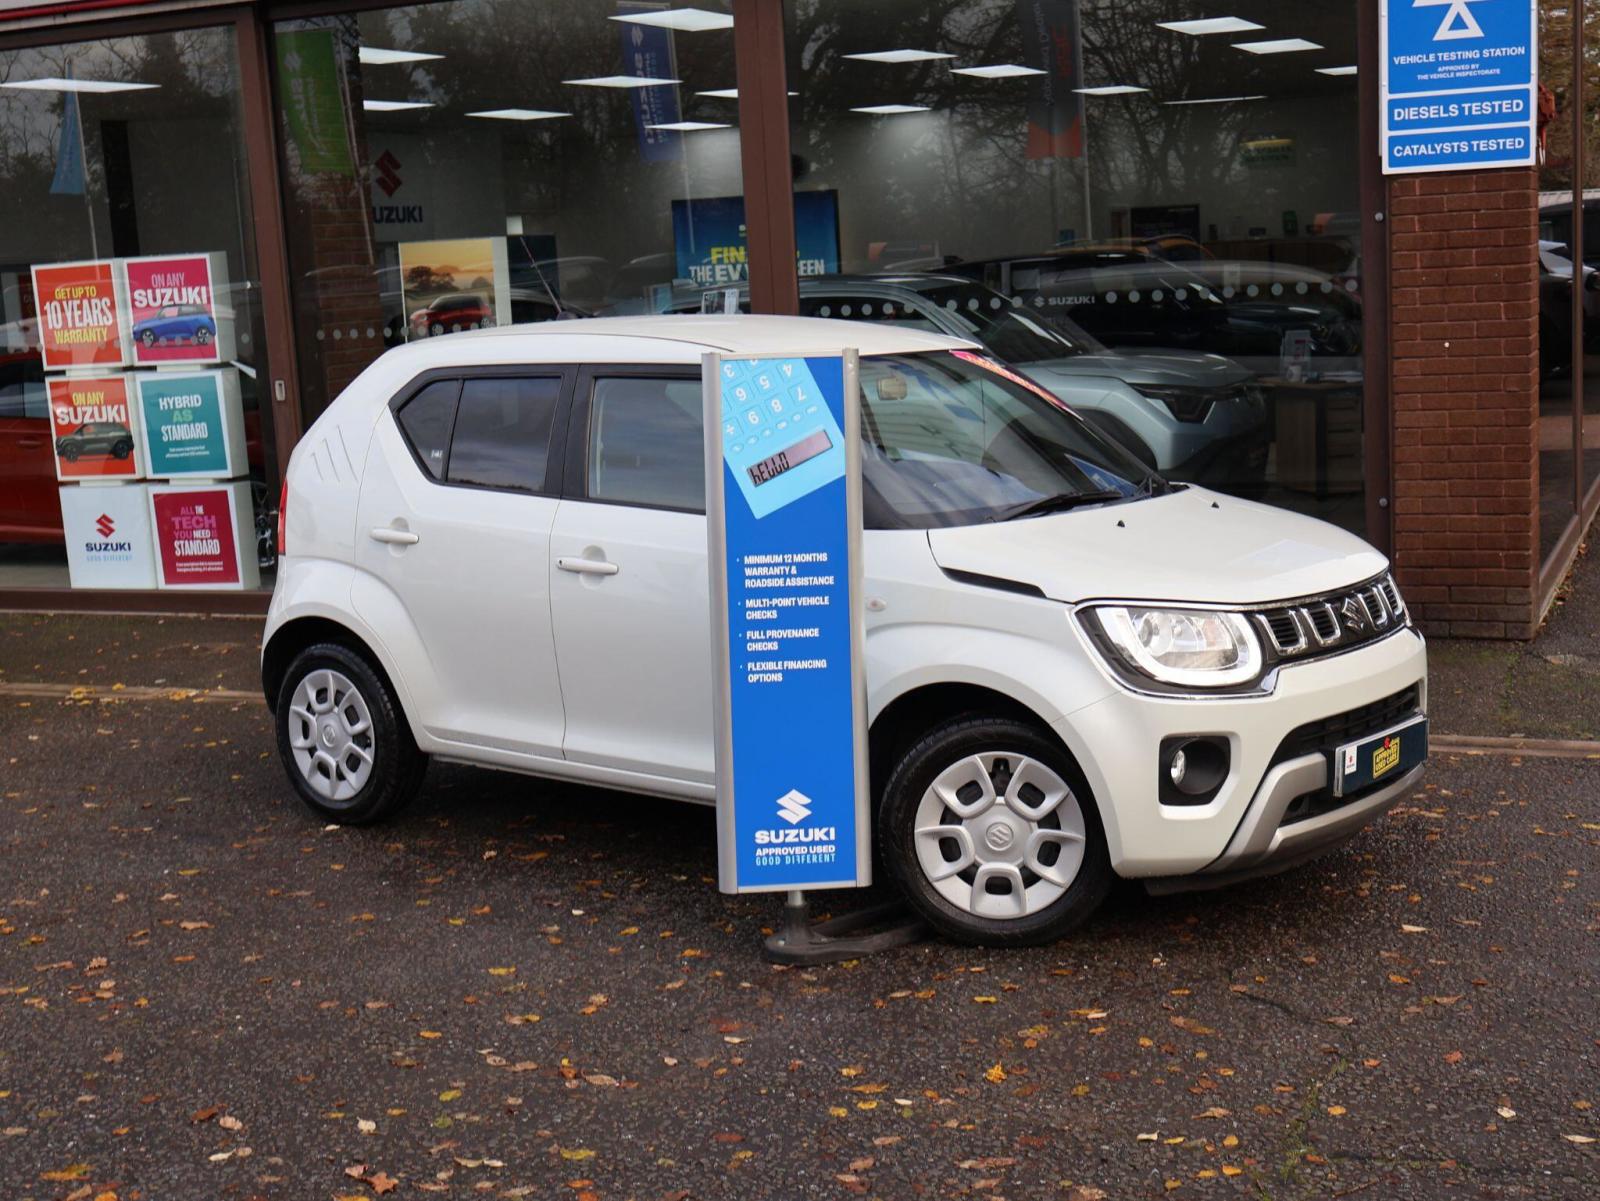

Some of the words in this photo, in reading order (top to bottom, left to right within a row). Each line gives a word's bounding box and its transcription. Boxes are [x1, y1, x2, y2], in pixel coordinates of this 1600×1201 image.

[1393, 54, 1435, 64] VEHICLE
[1438, 50, 1480, 61] TESTING
[1483, 46, 1525, 57] STATION
[1455, 69, 1500, 77] INSPECTORATE
[1394, 104, 1458, 120] DIESELS
[1461, 100, 1524, 116] TESTED
[1393, 142, 1468, 157] CATALYSTS
[1471, 138, 1524, 151] TESTED
[152, 274, 165, 287] ON
[166, 272, 185, 286] ANY
[688, 264, 713, 284] THE
[714, 263, 742, 281] EV
[55, 287, 71, 299] GET
[74, 286, 84, 297] UP
[84, 286, 96, 297] TO
[133, 286, 208, 308] SUZUKI
[1048, 296, 1096, 306] SUZUKI
[44, 301, 62, 329] 10
[62, 297, 113, 327] YEARS
[54, 327, 108, 344] WARRANTY
[72, 392, 86, 406] ON
[87, 391, 104, 405] ANY
[159, 394, 202, 411] HYBRID
[56, 405, 126, 425] SUZUKI
[173, 410, 193, 422] AS
[161, 423, 208, 442] STANDARD
[181, 506, 194, 515] ALL
[171, 515, 216, 529] TECH
[173, 530, 192, 539] YOU
[193, 529, 211, 538] NEED
[86, 542, 131, 552] SUZUKI
[174, 539, 220, 556] STANDARD
[744, 555, 783, 564] MINIMUM
[784, 554, 792, 562] 12
[793, 553, 827, 562] MONTHS
[745, 566, 790, 576] WARRANTY
[791, 566, 797, 574] &
[745, 578, 785, 588] ROADSIDE
[786, 576, 834, 586] ASSISTANCE
[746, 598, 796, 608] MULTI-POINT
[797, 596, 829, 606] VEHICLE
[746, 610, 777, 619] CHECKS
[747, 631, 765, 639] FULL
[767, 628, 819, 638] PROVENANCE
[747, 642, 778, 651] CHECKS
[748, 661, 784, 671] FLEXIBLE
[784, 659, 827, 670] FINANCING
[748, 673, 783, 683] OPTIONS
[755, 827, 836, 844] SUZUKI
[756, 846, 808, 856] APPROVED
[756, 856, 781, 866] GOOD
